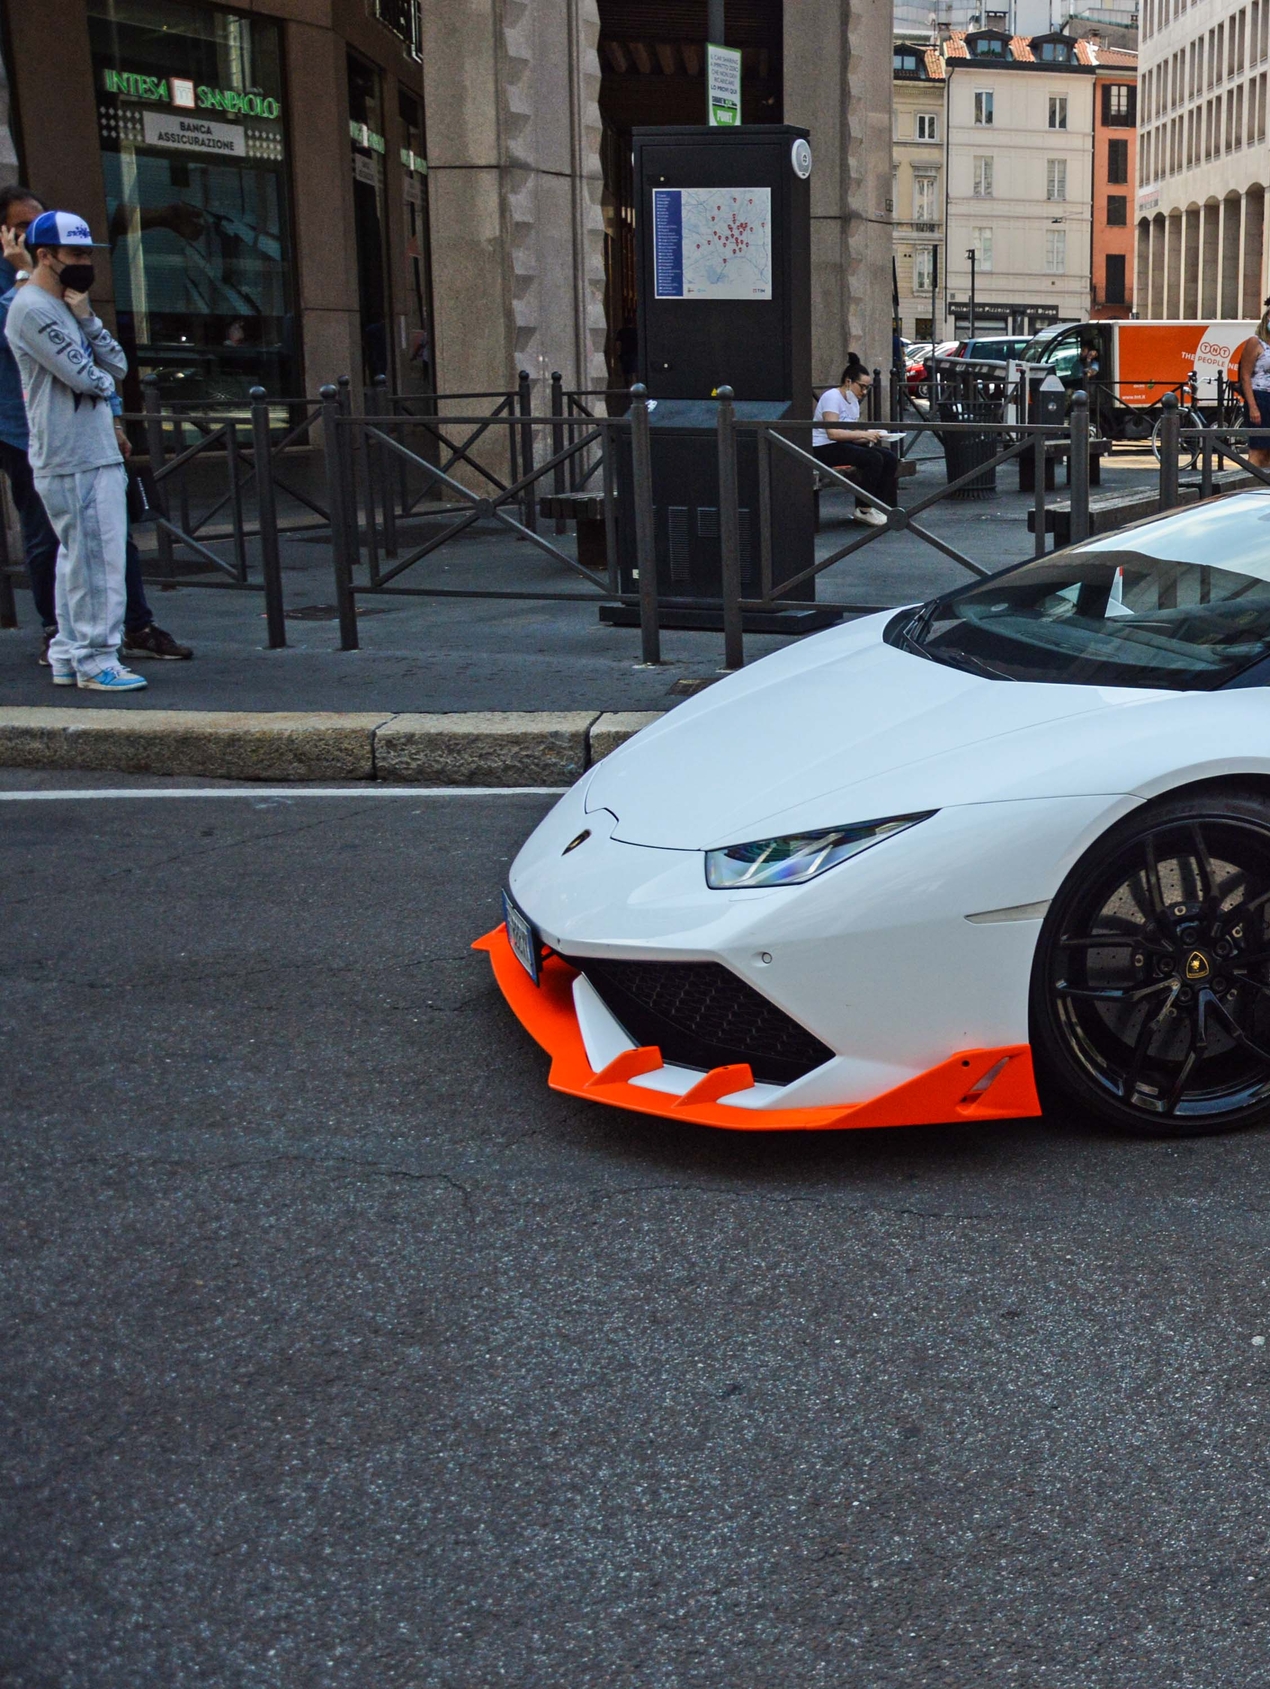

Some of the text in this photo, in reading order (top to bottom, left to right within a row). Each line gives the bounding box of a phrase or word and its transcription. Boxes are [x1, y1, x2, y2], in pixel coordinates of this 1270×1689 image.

[104, 69, 279, 119] INTESA SANPAOLO
[179, 121, 213, 136] BANCA
[157, 131, 235, 151] ASSICURAZIONE
[1201, 342, 1230, 357] TNT
[1181, 351, 1196, 361] THE
[1198, 355, 1225, 368] PEOPLE
